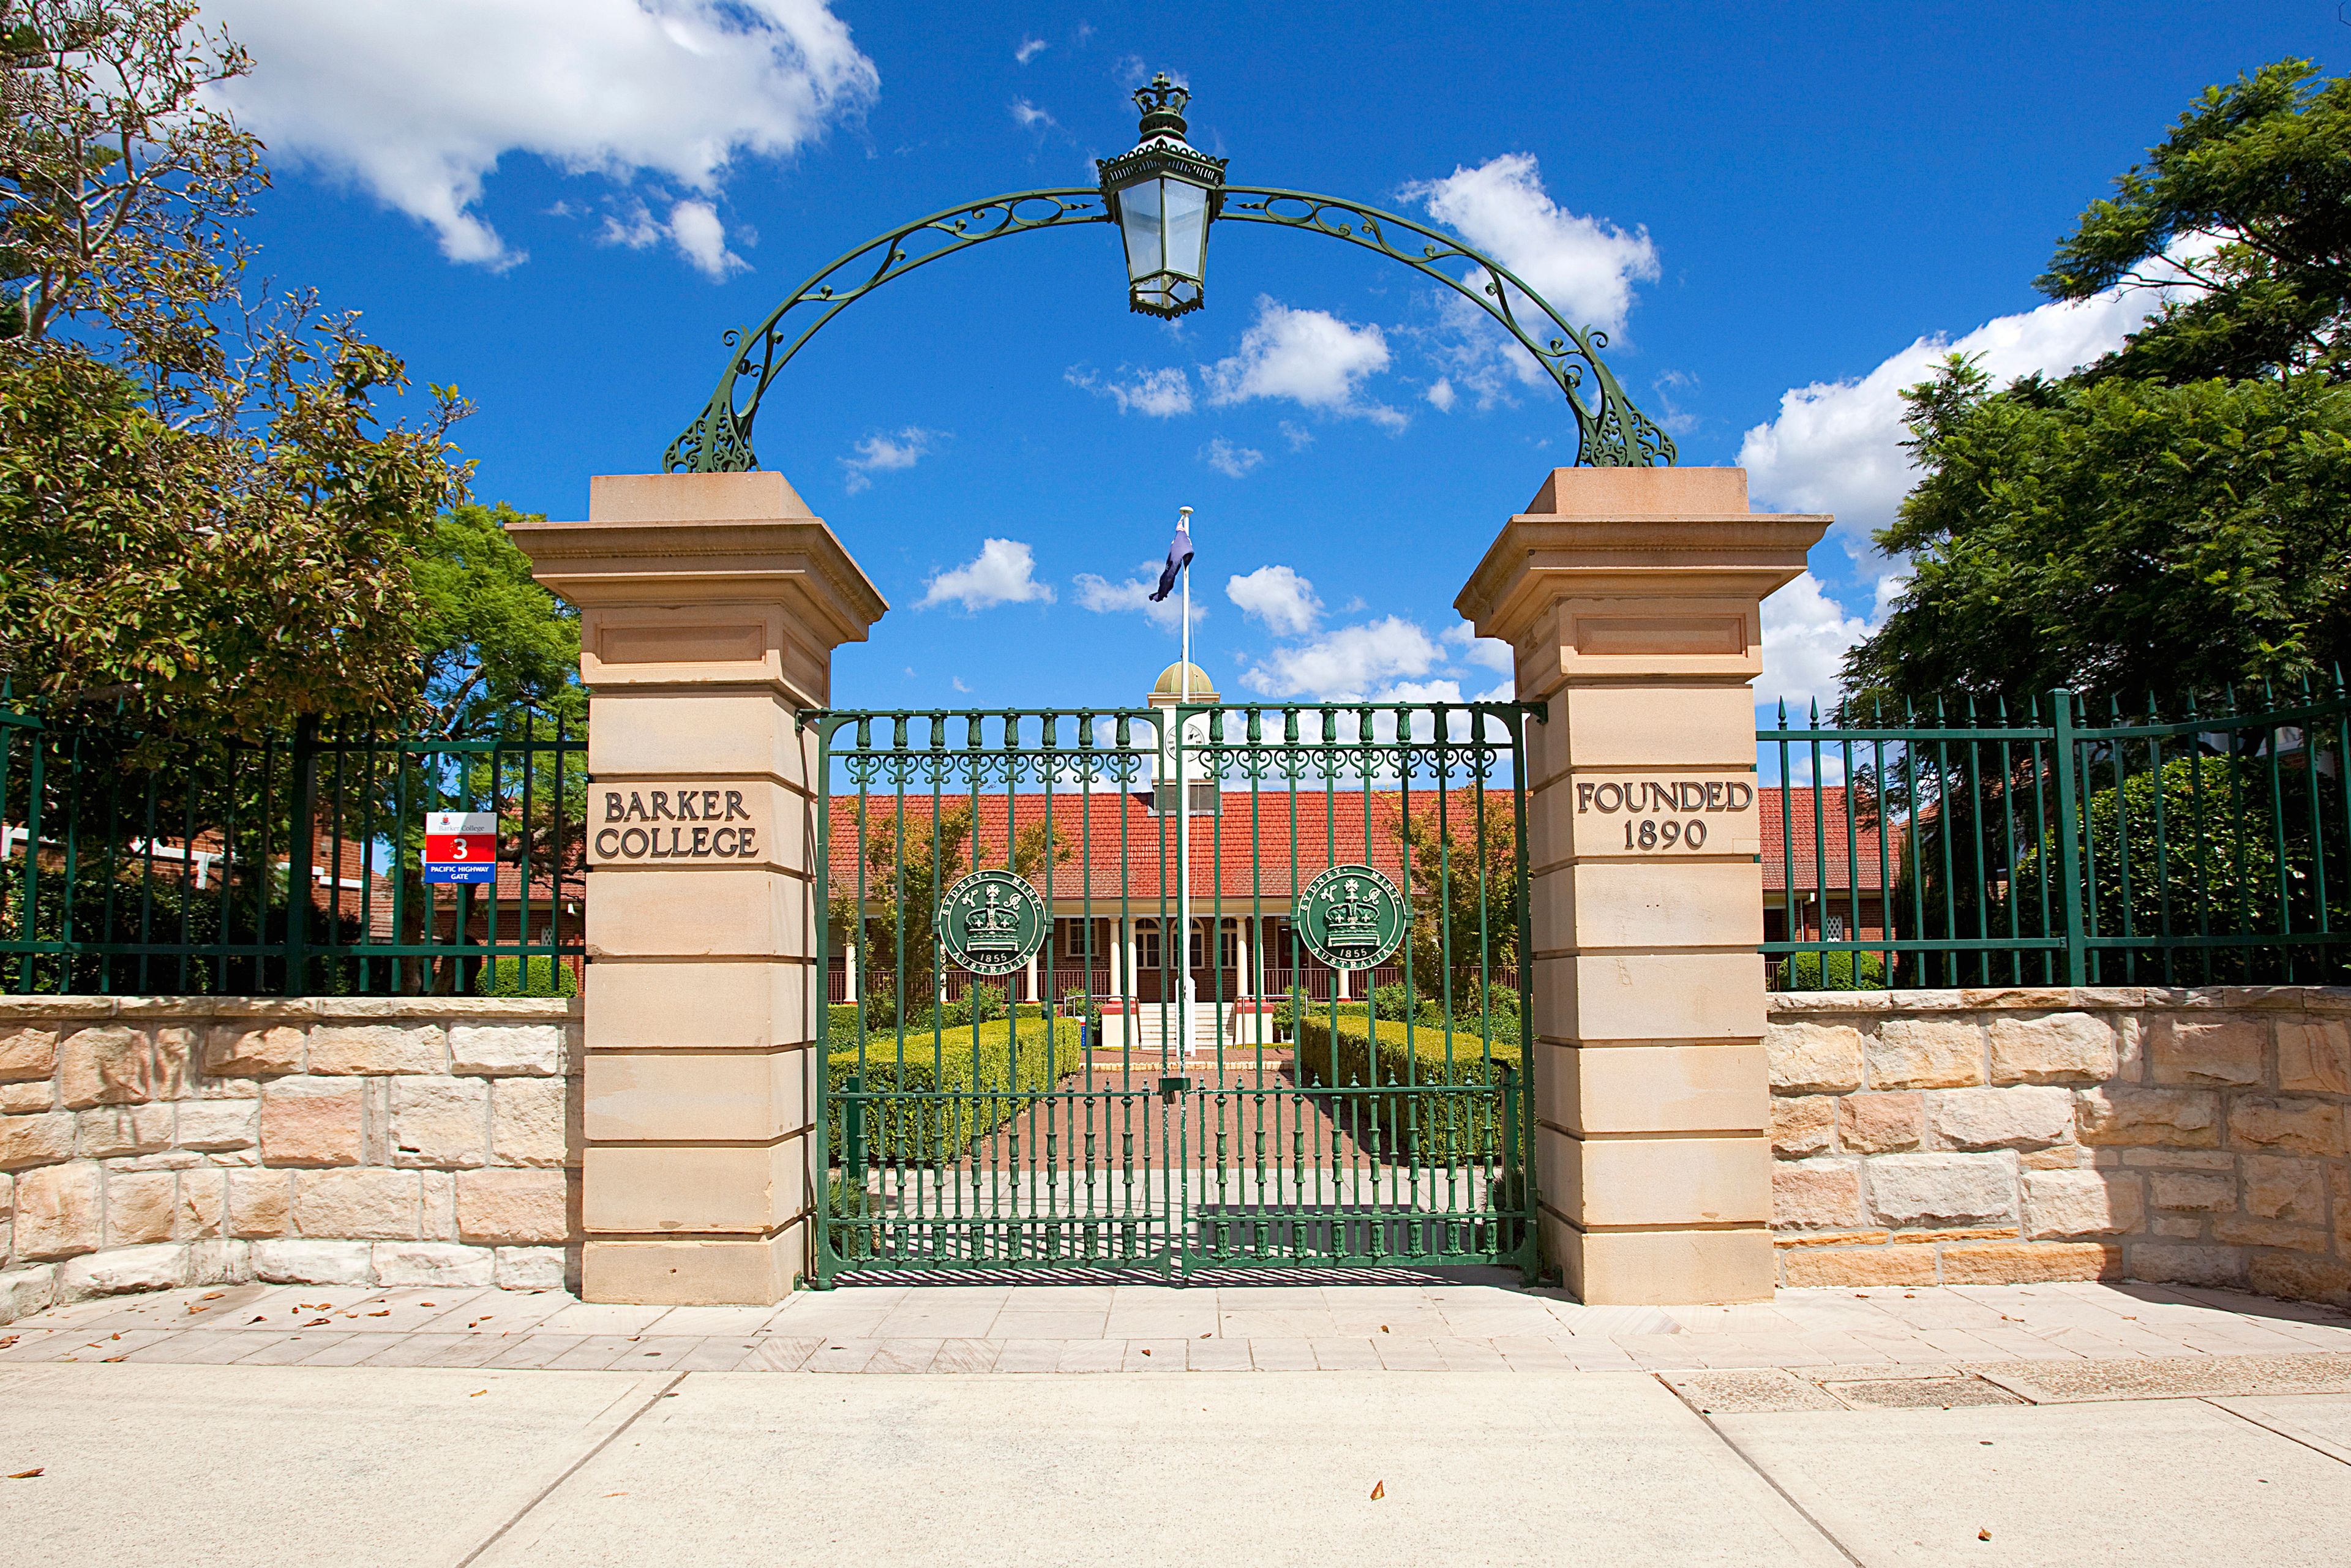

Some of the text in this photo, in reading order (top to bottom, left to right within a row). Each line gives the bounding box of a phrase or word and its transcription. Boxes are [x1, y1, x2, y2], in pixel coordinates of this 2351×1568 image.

[605, 790, 751, 822] BARKER
[1576, 781, 1753, 813] FOUNDED
[452, 838, 468, 860] 3
[595, 827, 759, 859] COLLEGE
[1624, 819, 1707, 850] 1890
[942, 872, 1041, 916] SYDNEY MINT
[1300, 868, 1400, 911] SYDNEY MINT
[952, 951, 1031, 973] AUSTRALIA
[980, 953, 1008, 963] 1855
[1312, 947, 1391, 969] AUSTRALIA
[1340, 948, 1368, 958] 1855
